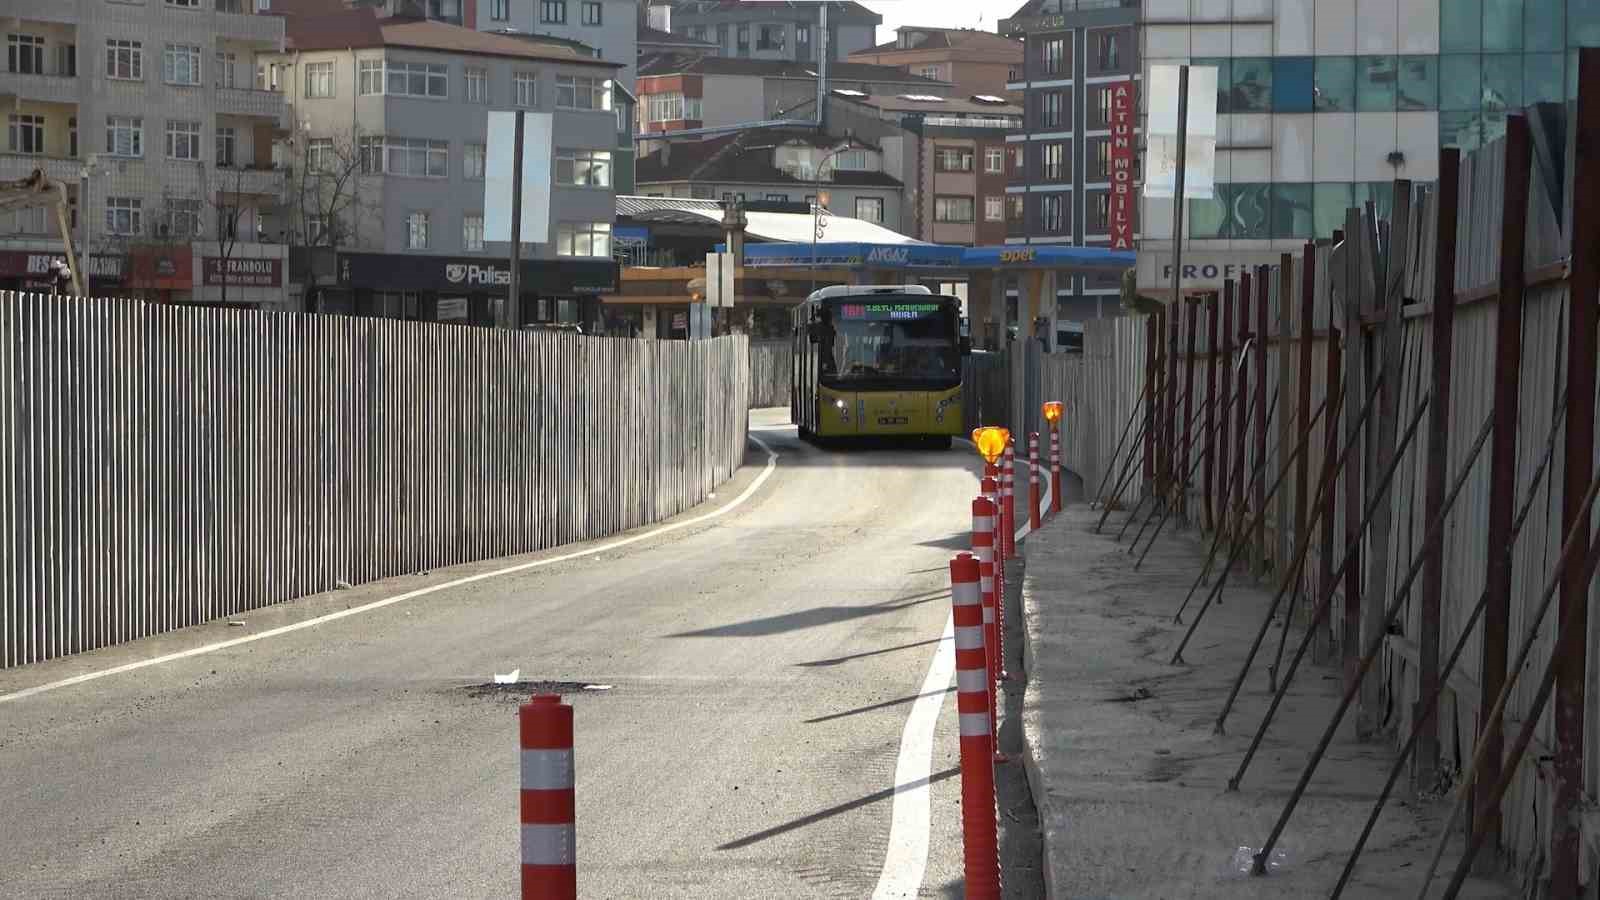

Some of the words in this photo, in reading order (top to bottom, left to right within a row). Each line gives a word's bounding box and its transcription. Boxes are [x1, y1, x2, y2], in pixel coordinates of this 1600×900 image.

[1115, 87, 1128, 148] ALTUN
[1114, 158, 1129, 249] MOBİLYA
[216, 260, 272, 273] SFRANBOLU
